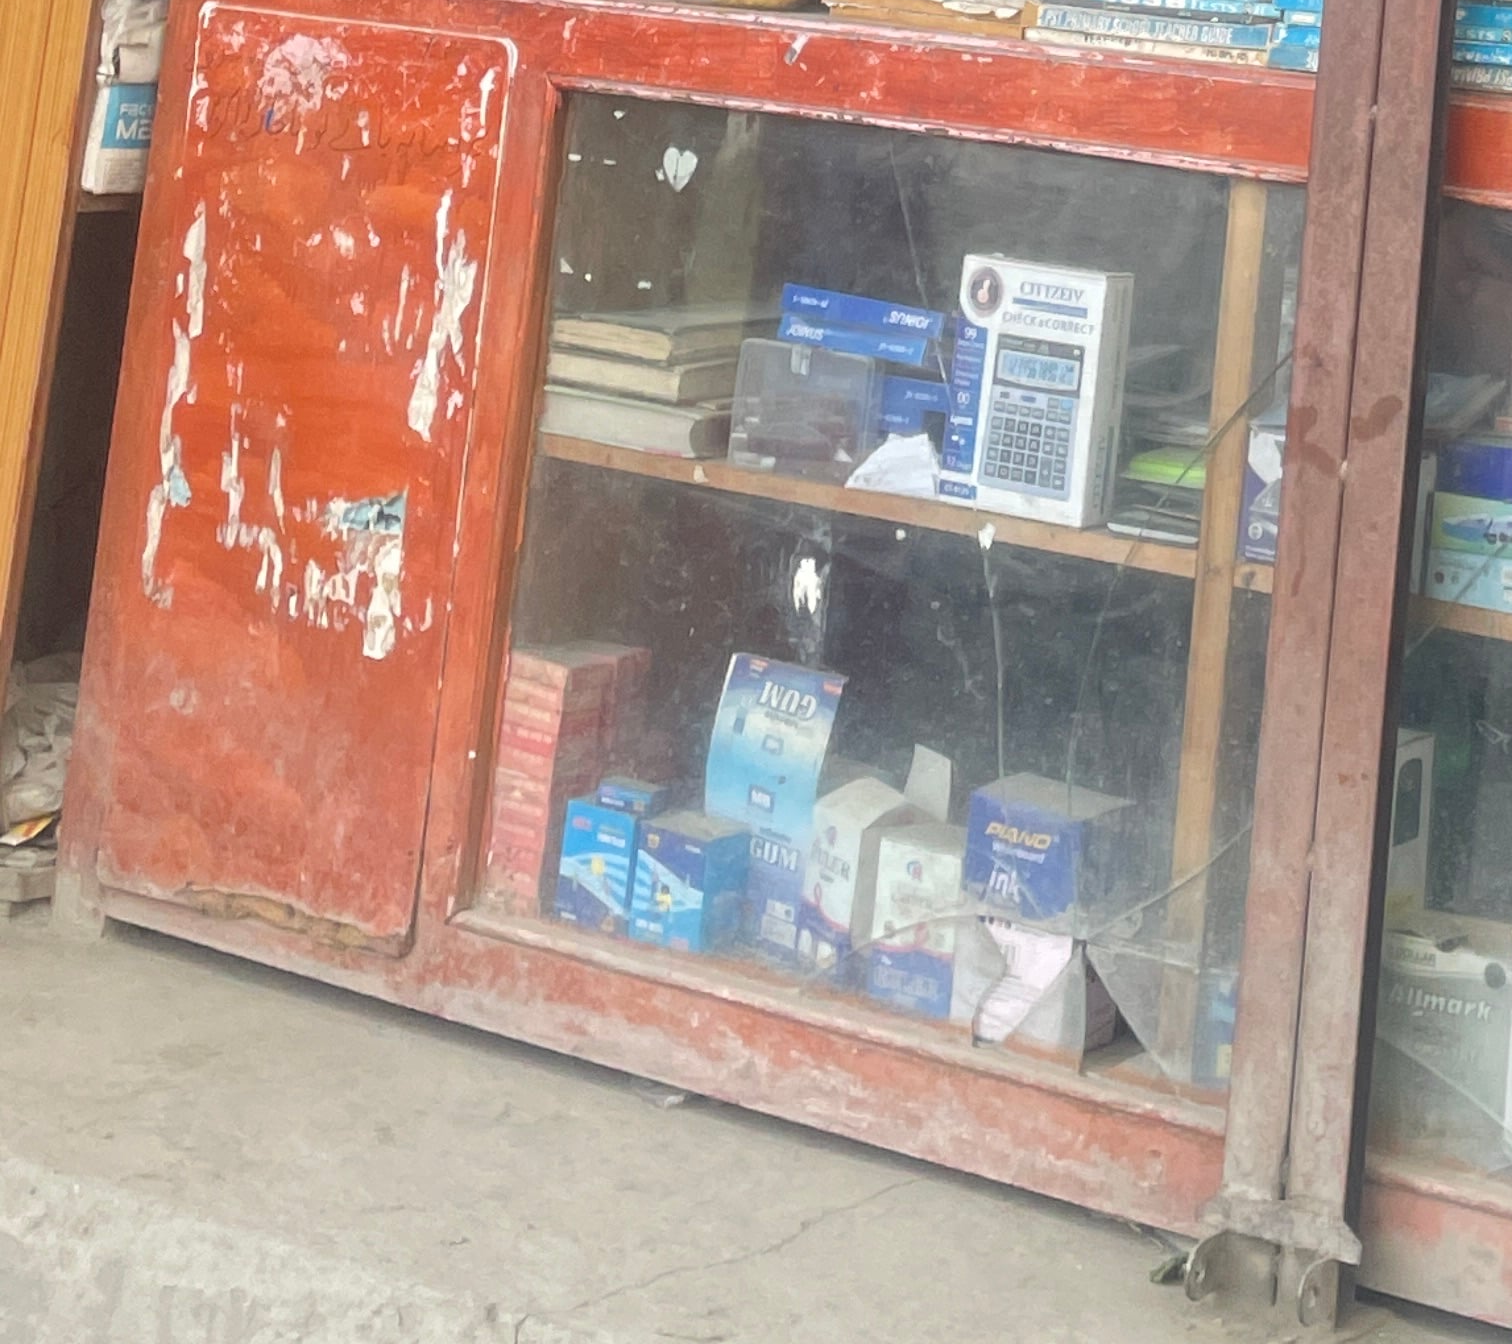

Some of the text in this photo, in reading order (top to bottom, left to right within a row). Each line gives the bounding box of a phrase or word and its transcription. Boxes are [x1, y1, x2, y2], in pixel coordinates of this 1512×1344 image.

[759, 680, 817, 721] GUM
[985, 821, 1054, 851] PIANO
[749, 837, 798, 873] GUM
